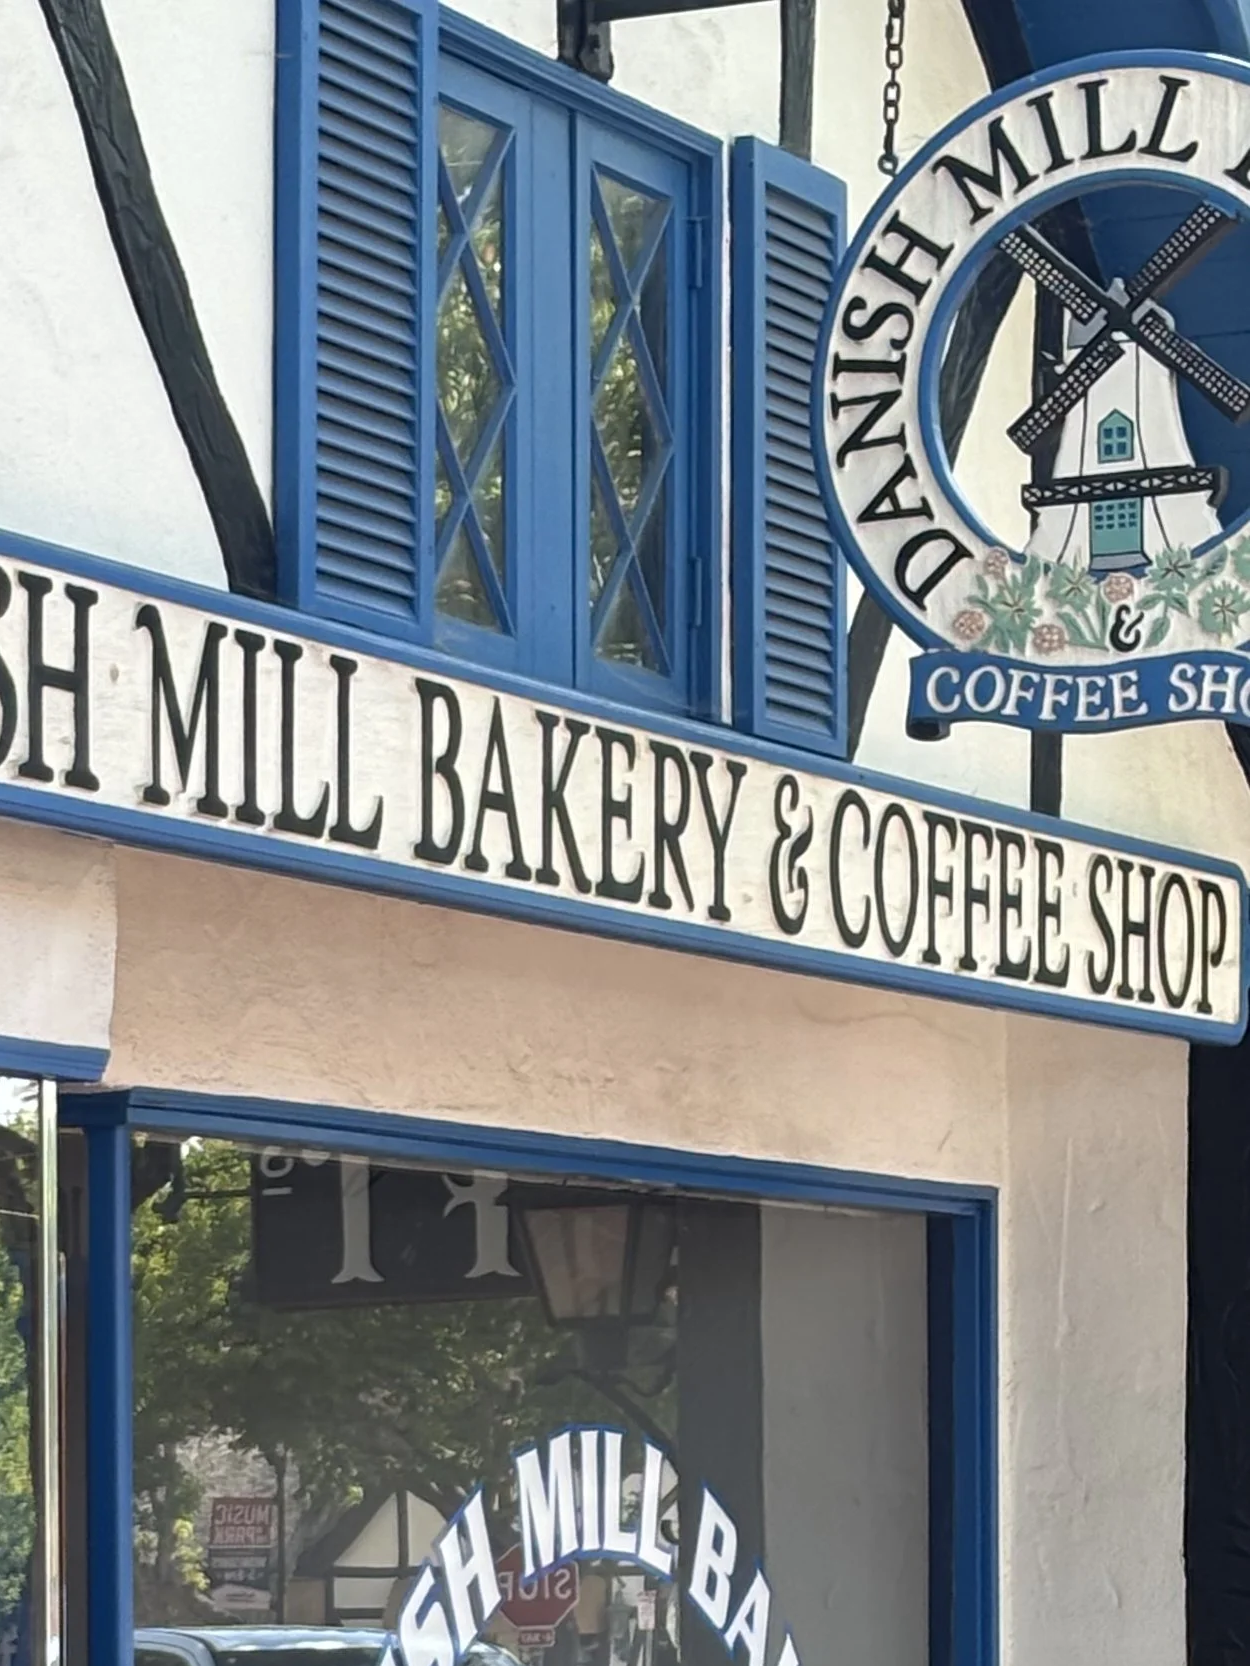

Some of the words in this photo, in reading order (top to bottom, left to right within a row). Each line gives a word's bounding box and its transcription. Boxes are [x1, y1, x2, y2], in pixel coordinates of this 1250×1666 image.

[831, 210, 973, 612] DANISH
[932, 74, 1199, 226] MILL
[925, 663, 1149, 722] COFFEE
[1110, 604, 1144, 653] &
[136, 604, 383, 850] MILL
[414, 677, 748, 923] BAKERY
[769, 773, 815, 936] &
[831, 788, 1070, 988] COFFEE
[1086, 853, 1227, 1015] SHOP
[513, 1424, 680, 1581] MILL
